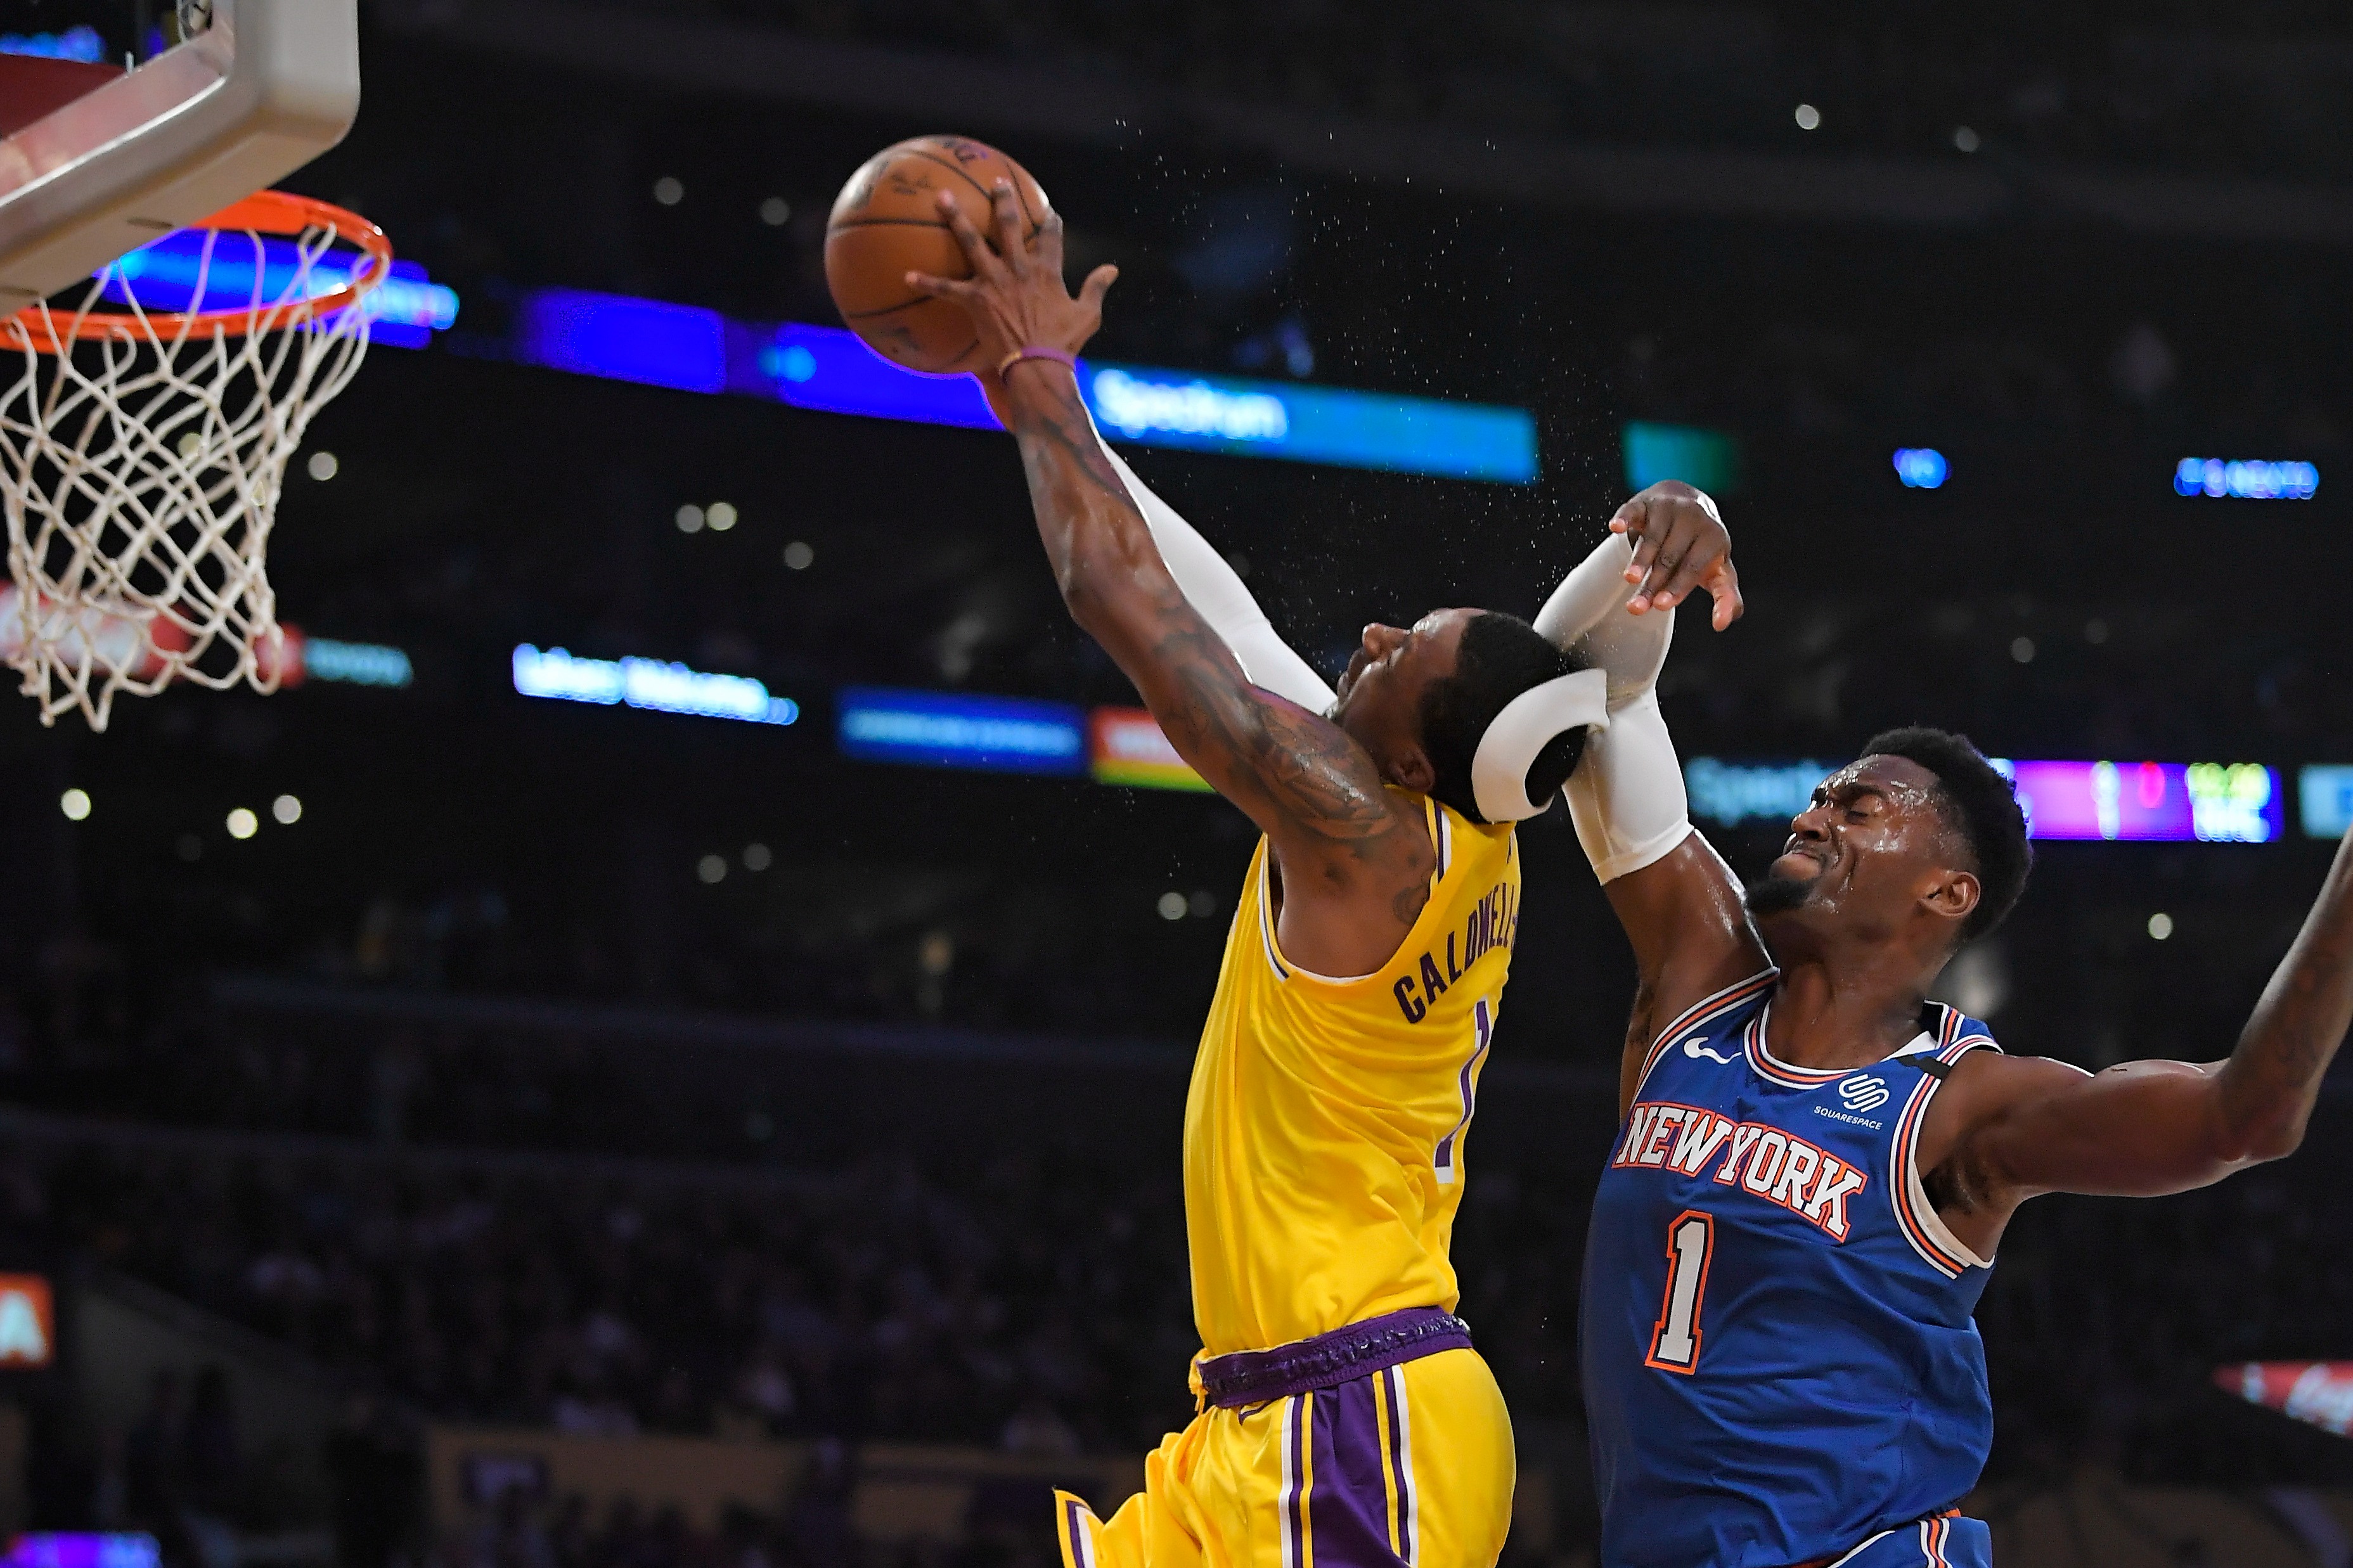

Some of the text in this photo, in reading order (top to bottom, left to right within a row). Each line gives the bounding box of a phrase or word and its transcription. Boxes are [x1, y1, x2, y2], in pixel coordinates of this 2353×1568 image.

[1612, 1102, 1868, 1243] NEW YORK
[1814, 1105, 1883, 1131] SQUARESPACE
[1645, 1209, 1714, 1375] 1
